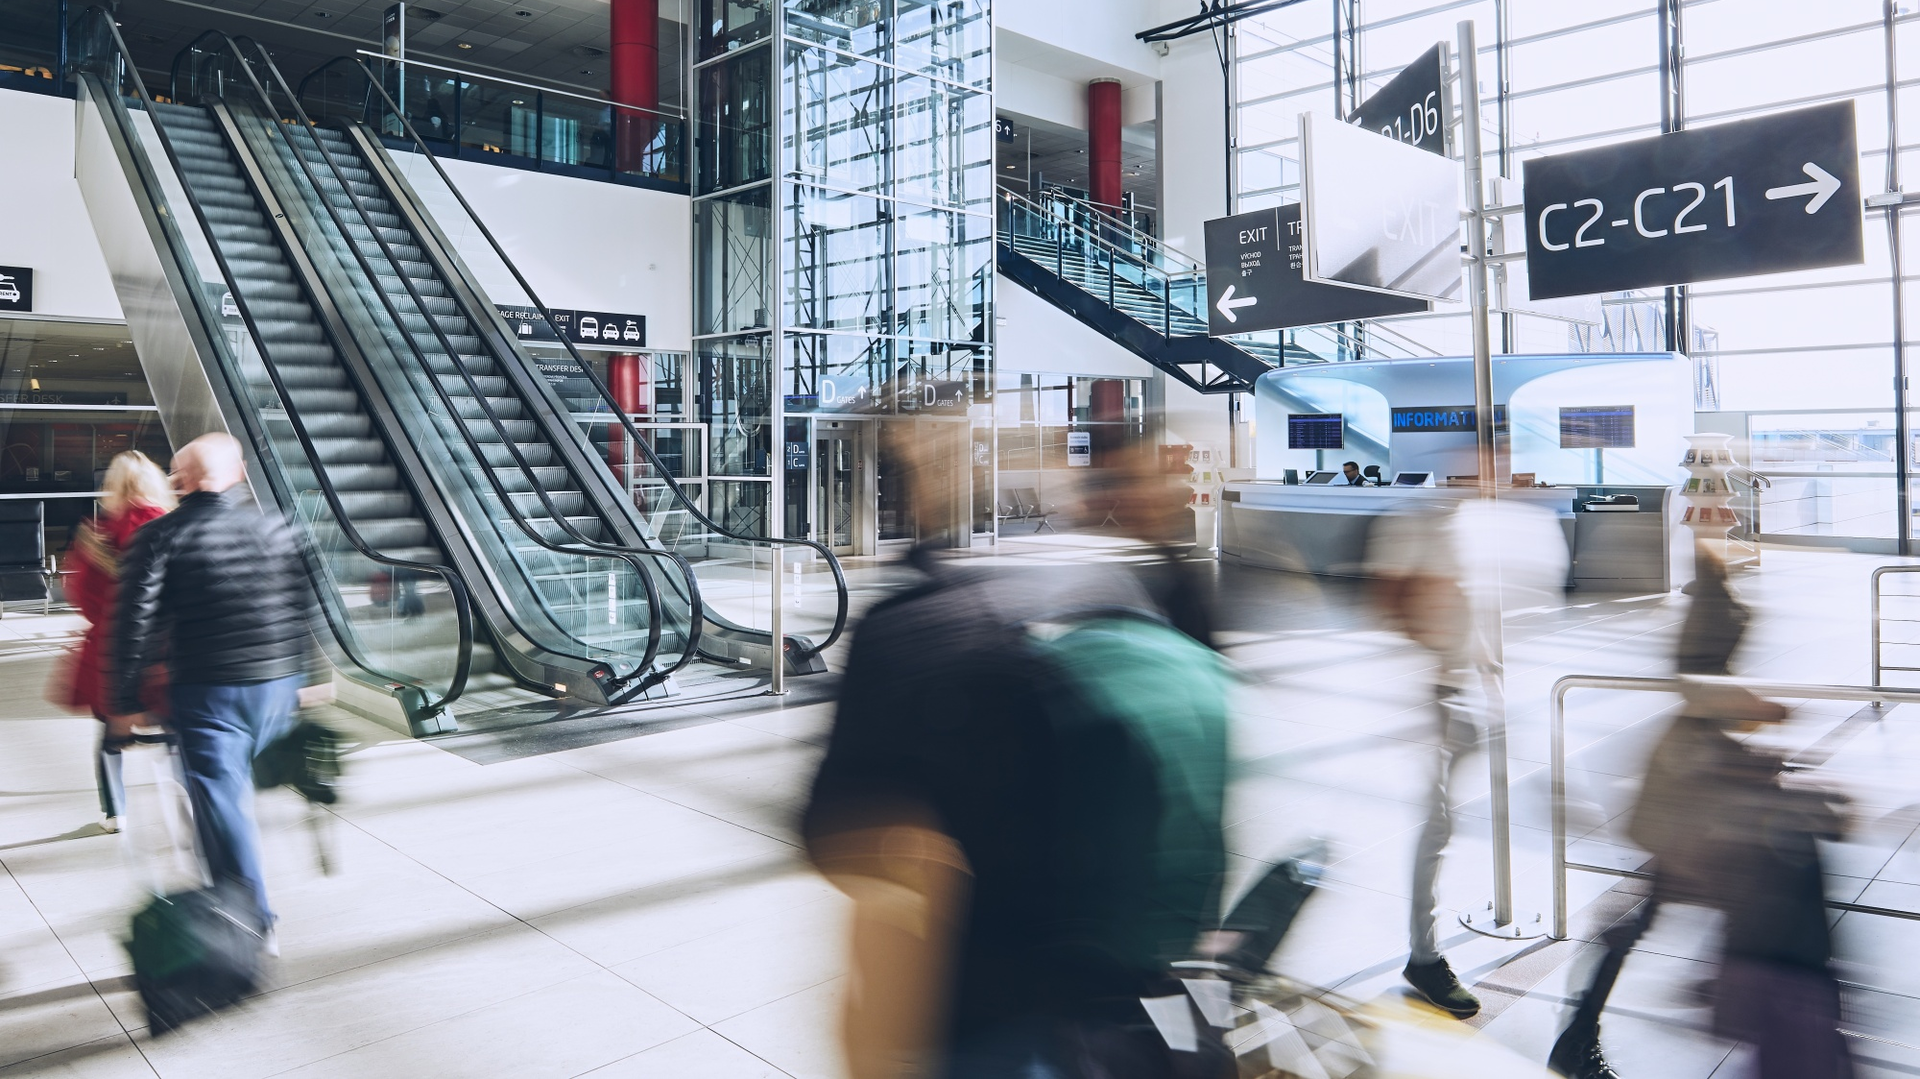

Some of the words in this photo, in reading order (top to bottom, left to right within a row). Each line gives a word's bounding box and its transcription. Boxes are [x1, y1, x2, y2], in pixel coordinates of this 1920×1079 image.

[1381, 90, 1438, 146] 1-D6
[1539, 175, 1736, 251] C2-C21
[1382, 197, 1439, 248] EXIT
[1239, 226, 1268, 244] EXIT
[1240, 251, 1262, 260] VÝCHOD
[555, 314, 570, 322] EXIT
[570, 365, 584, 373] DES
[33, 394, 63, 404] DESK
[821, 379, 836, 404] D
[836, 396, 856, 404] GATES
[924, 384, 936, 406] D
[937, 399, 954, 407] GATES
[793, 444, 799, 454] D
